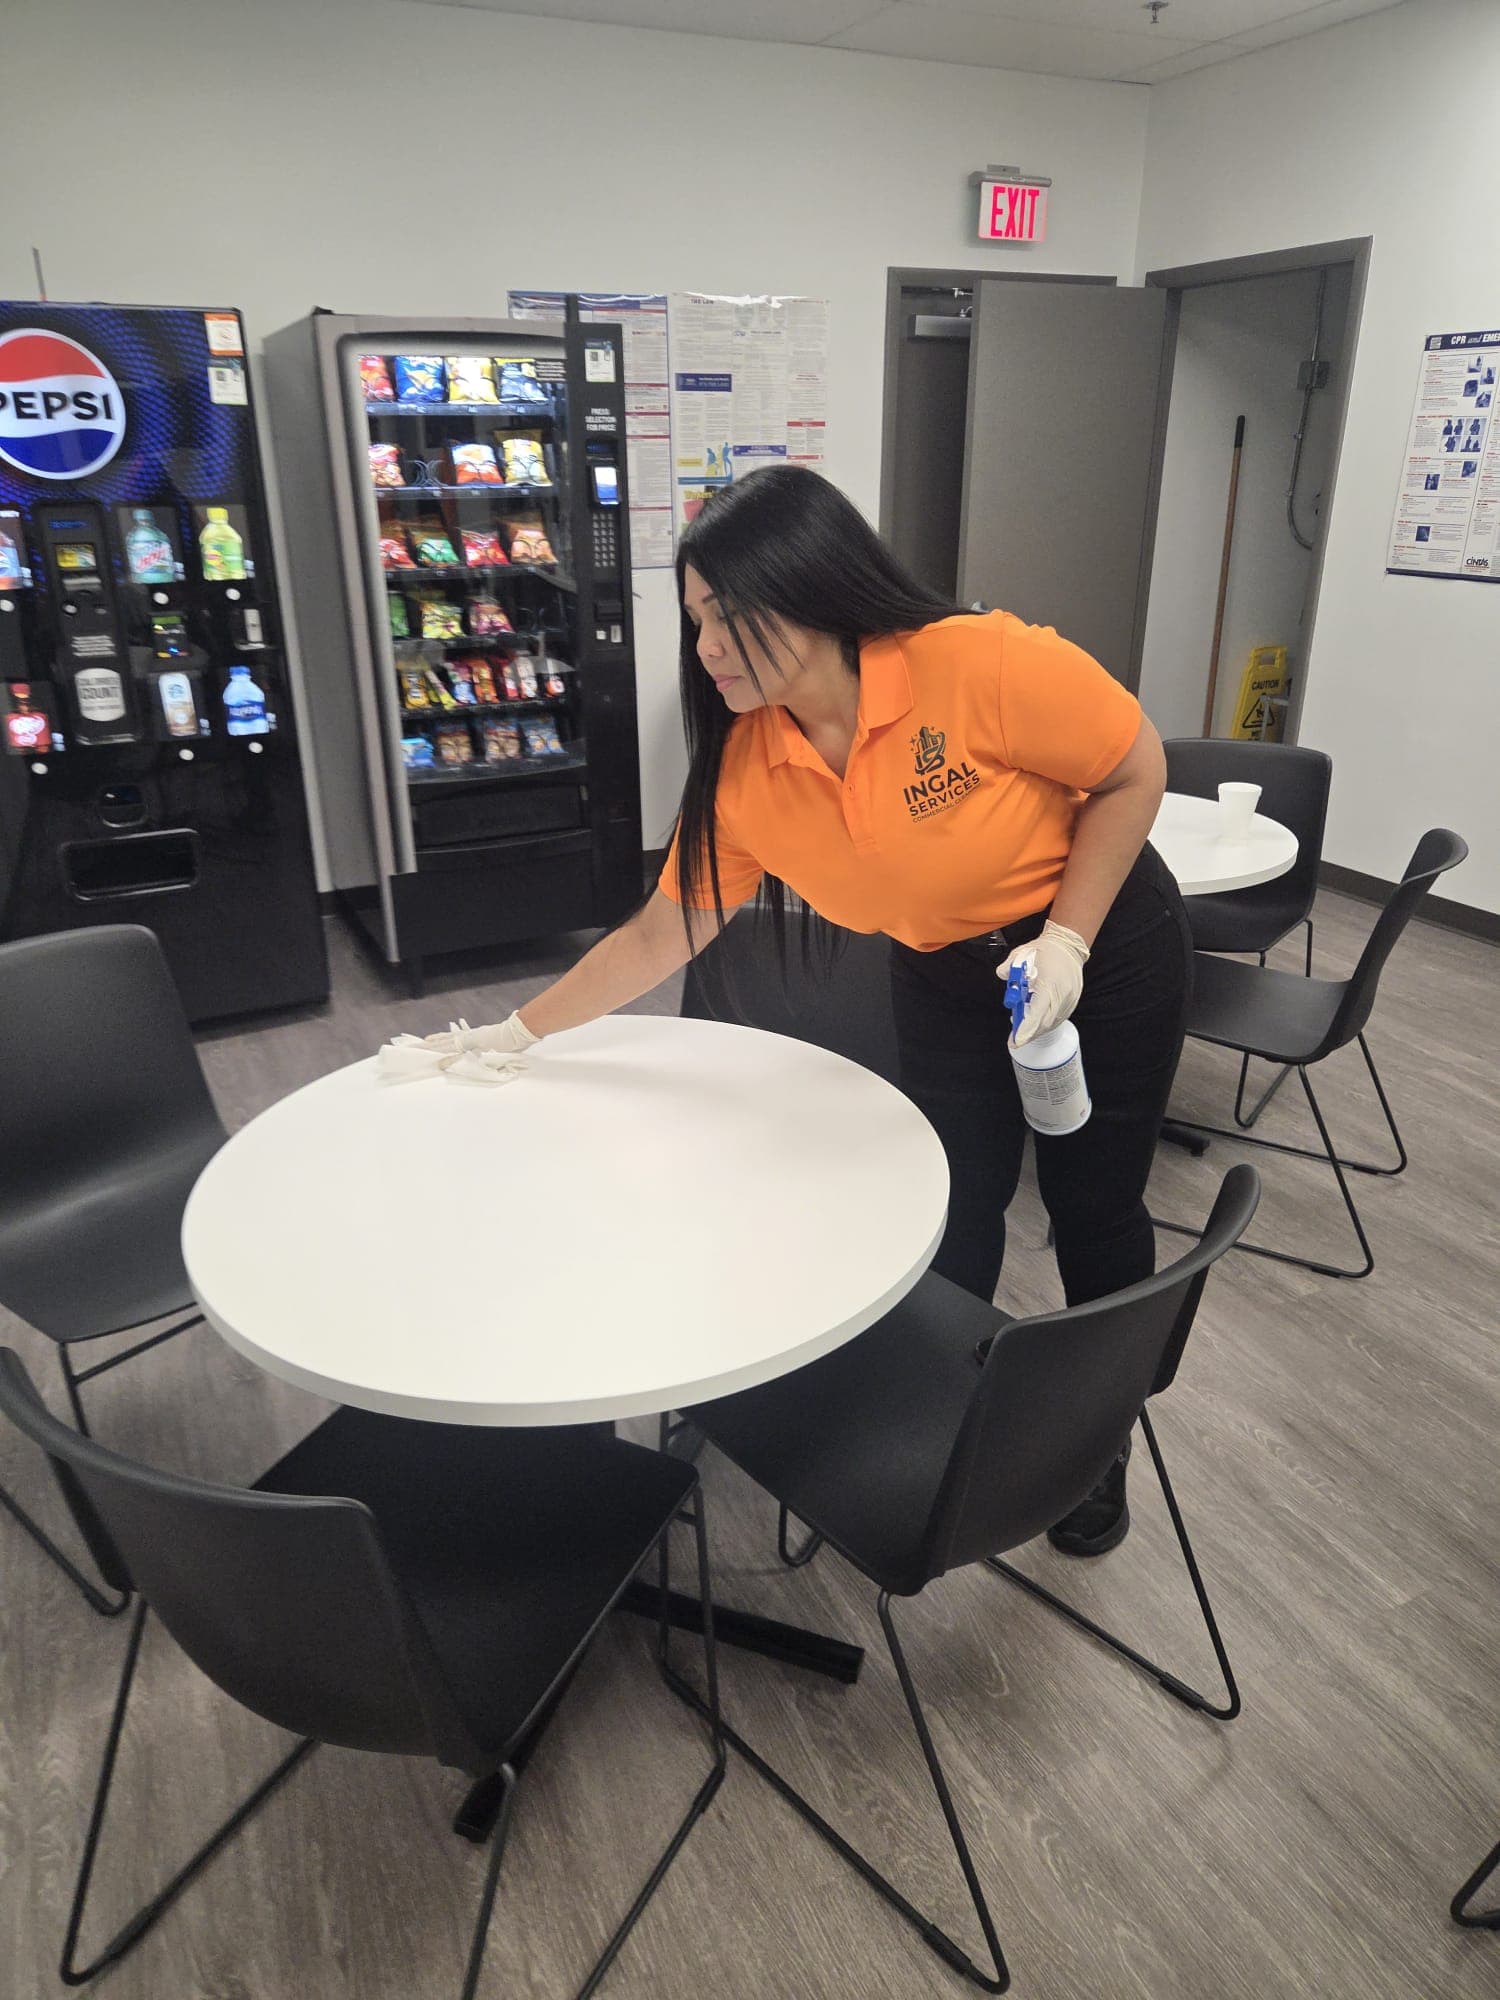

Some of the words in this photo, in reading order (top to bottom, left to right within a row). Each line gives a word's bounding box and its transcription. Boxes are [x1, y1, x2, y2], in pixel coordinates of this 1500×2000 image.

[991, 186, 1040, 239] EXIT
[1451, 335, 1466, 345] CPR
[0, 391, 113, 420] EPSI
[1251, 680, 1280, 690] CAUTION
[903, 762, 976, 805] INGAL
[909, 774, 980, 817] SERVICES
